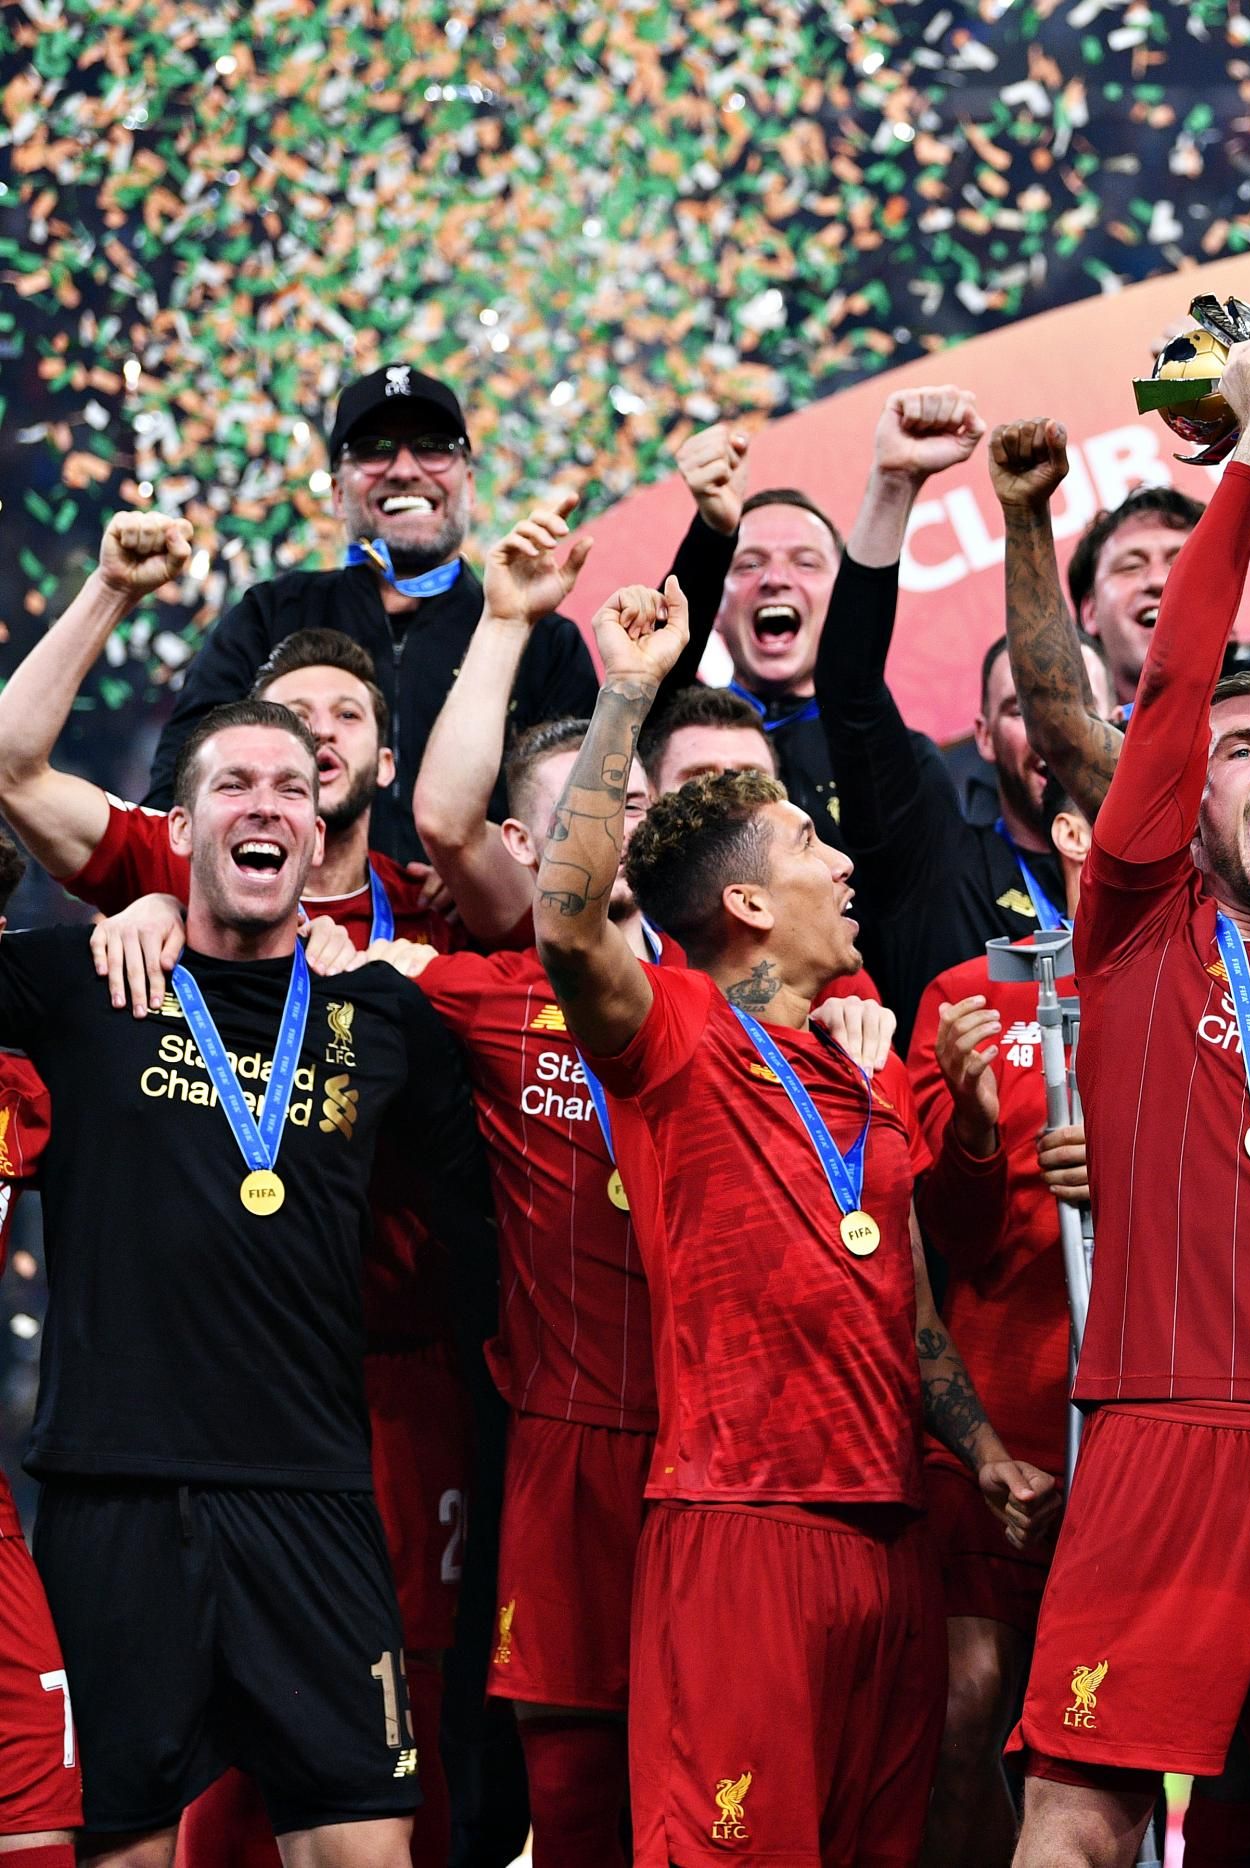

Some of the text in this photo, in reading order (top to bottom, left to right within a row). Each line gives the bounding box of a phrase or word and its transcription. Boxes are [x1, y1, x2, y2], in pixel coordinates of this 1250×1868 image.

[159, 1035, 315, 1091] Stndad
[1006, 1044, 1034, 1067] 48
[141, 1067, 312, 1127] Charerd
[249, 1189, 276, 1198] FIFA
[849, 1227, 872, 1240] FIFA
[371, 1648, 415, 1749] 1
